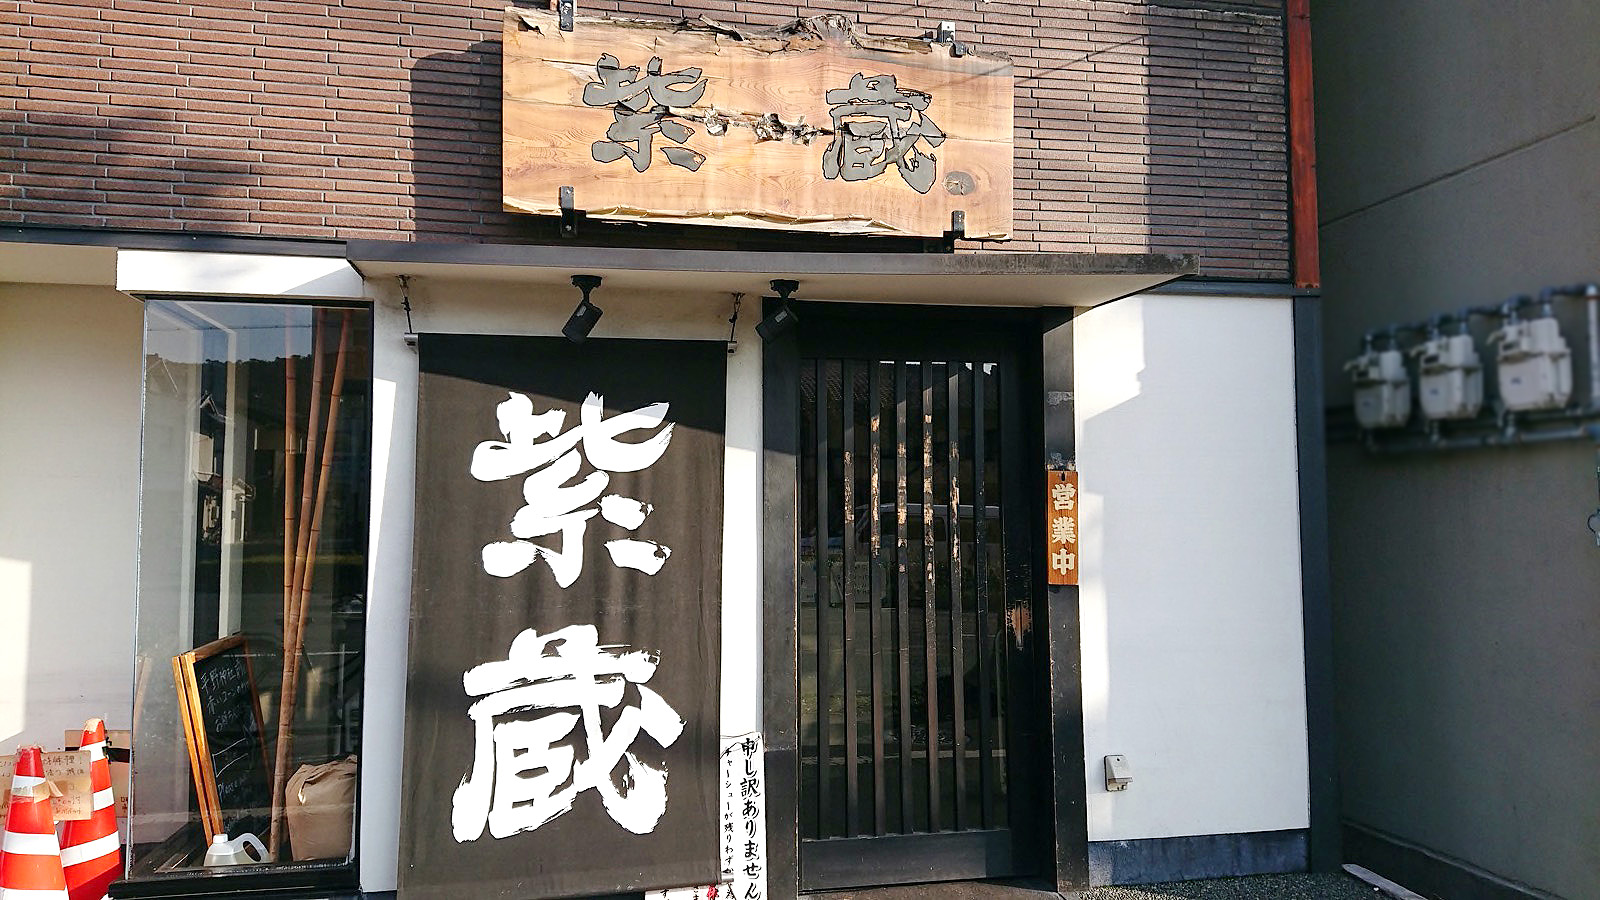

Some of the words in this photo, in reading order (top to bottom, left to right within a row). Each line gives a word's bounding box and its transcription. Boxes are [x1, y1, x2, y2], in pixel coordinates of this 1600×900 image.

[1052, 483, 1076, 576] 営業中
[451, 391, 687, 843] 紫蔵
[740, 737, 762, 900] 申し訳ありません
